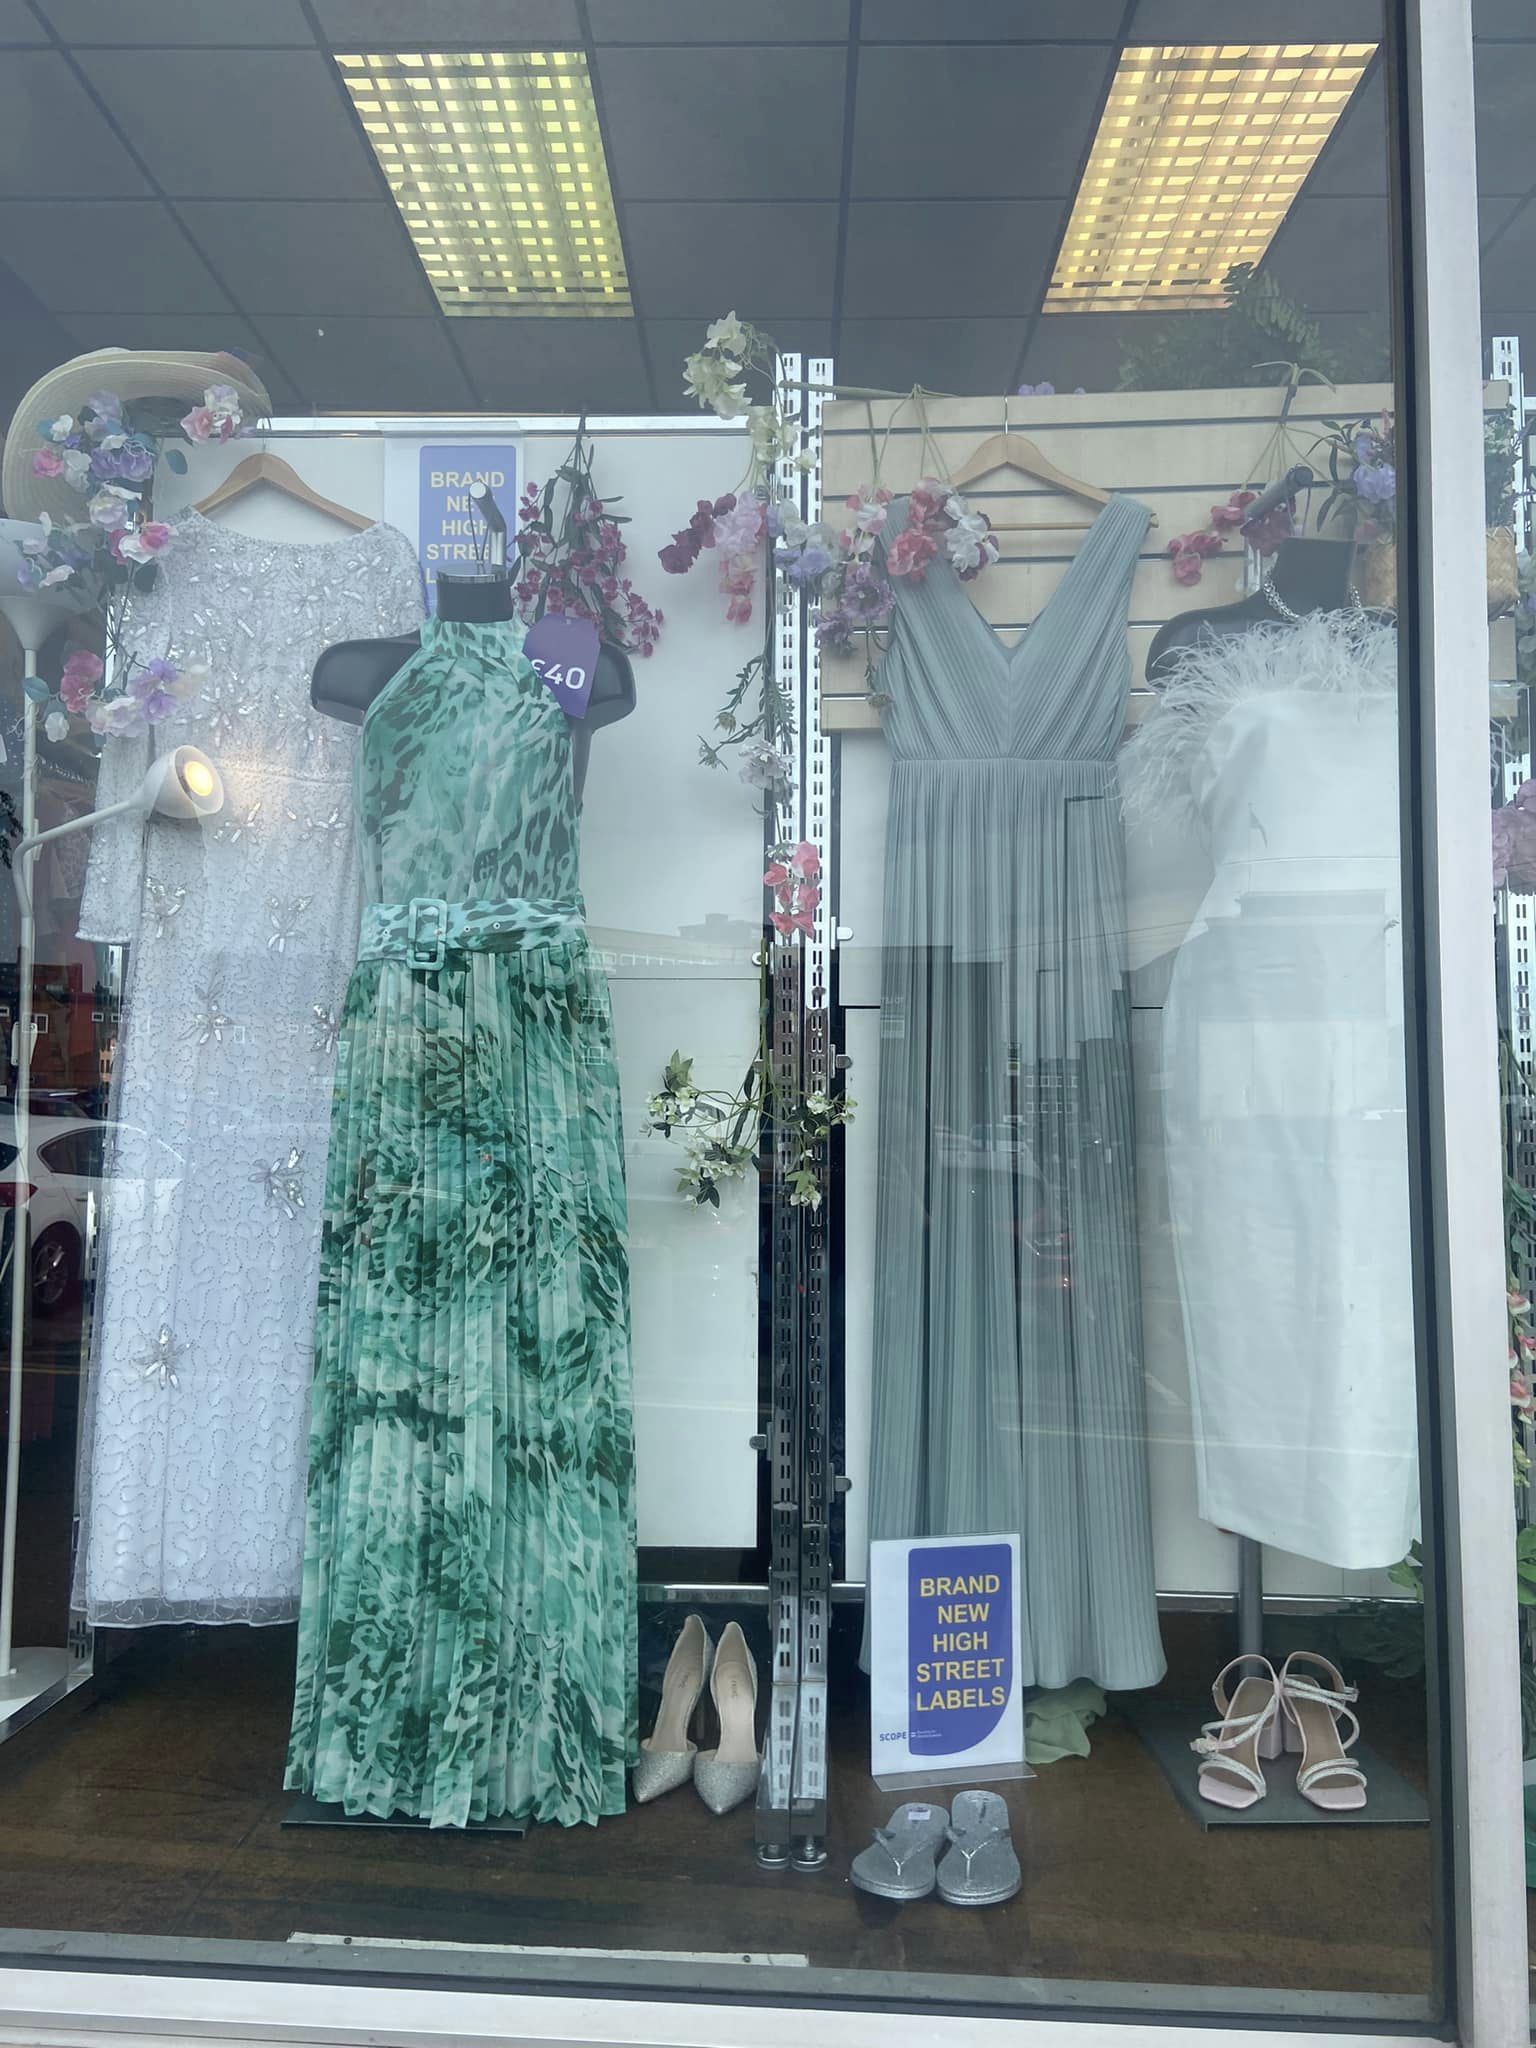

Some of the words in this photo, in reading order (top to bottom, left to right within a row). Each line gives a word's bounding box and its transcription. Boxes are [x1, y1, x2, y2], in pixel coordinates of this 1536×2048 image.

[431, 471, 505, 488] BRAND
[447, 496, 475, 512] NE
[427, 544, 490, 560] STREE
[531, 659, 585, 689] £40
[920, 1575, 1000, 1597] BRAND
[938, 1603, 989, 1624] NEW
[933, 1631, 988, 1653] HIGH
[916, 1658, 1005, 1682] STREET
[916, 1686, 1005, 1711] LABELS
[880, 1731, 907, 1742] SCOPE
